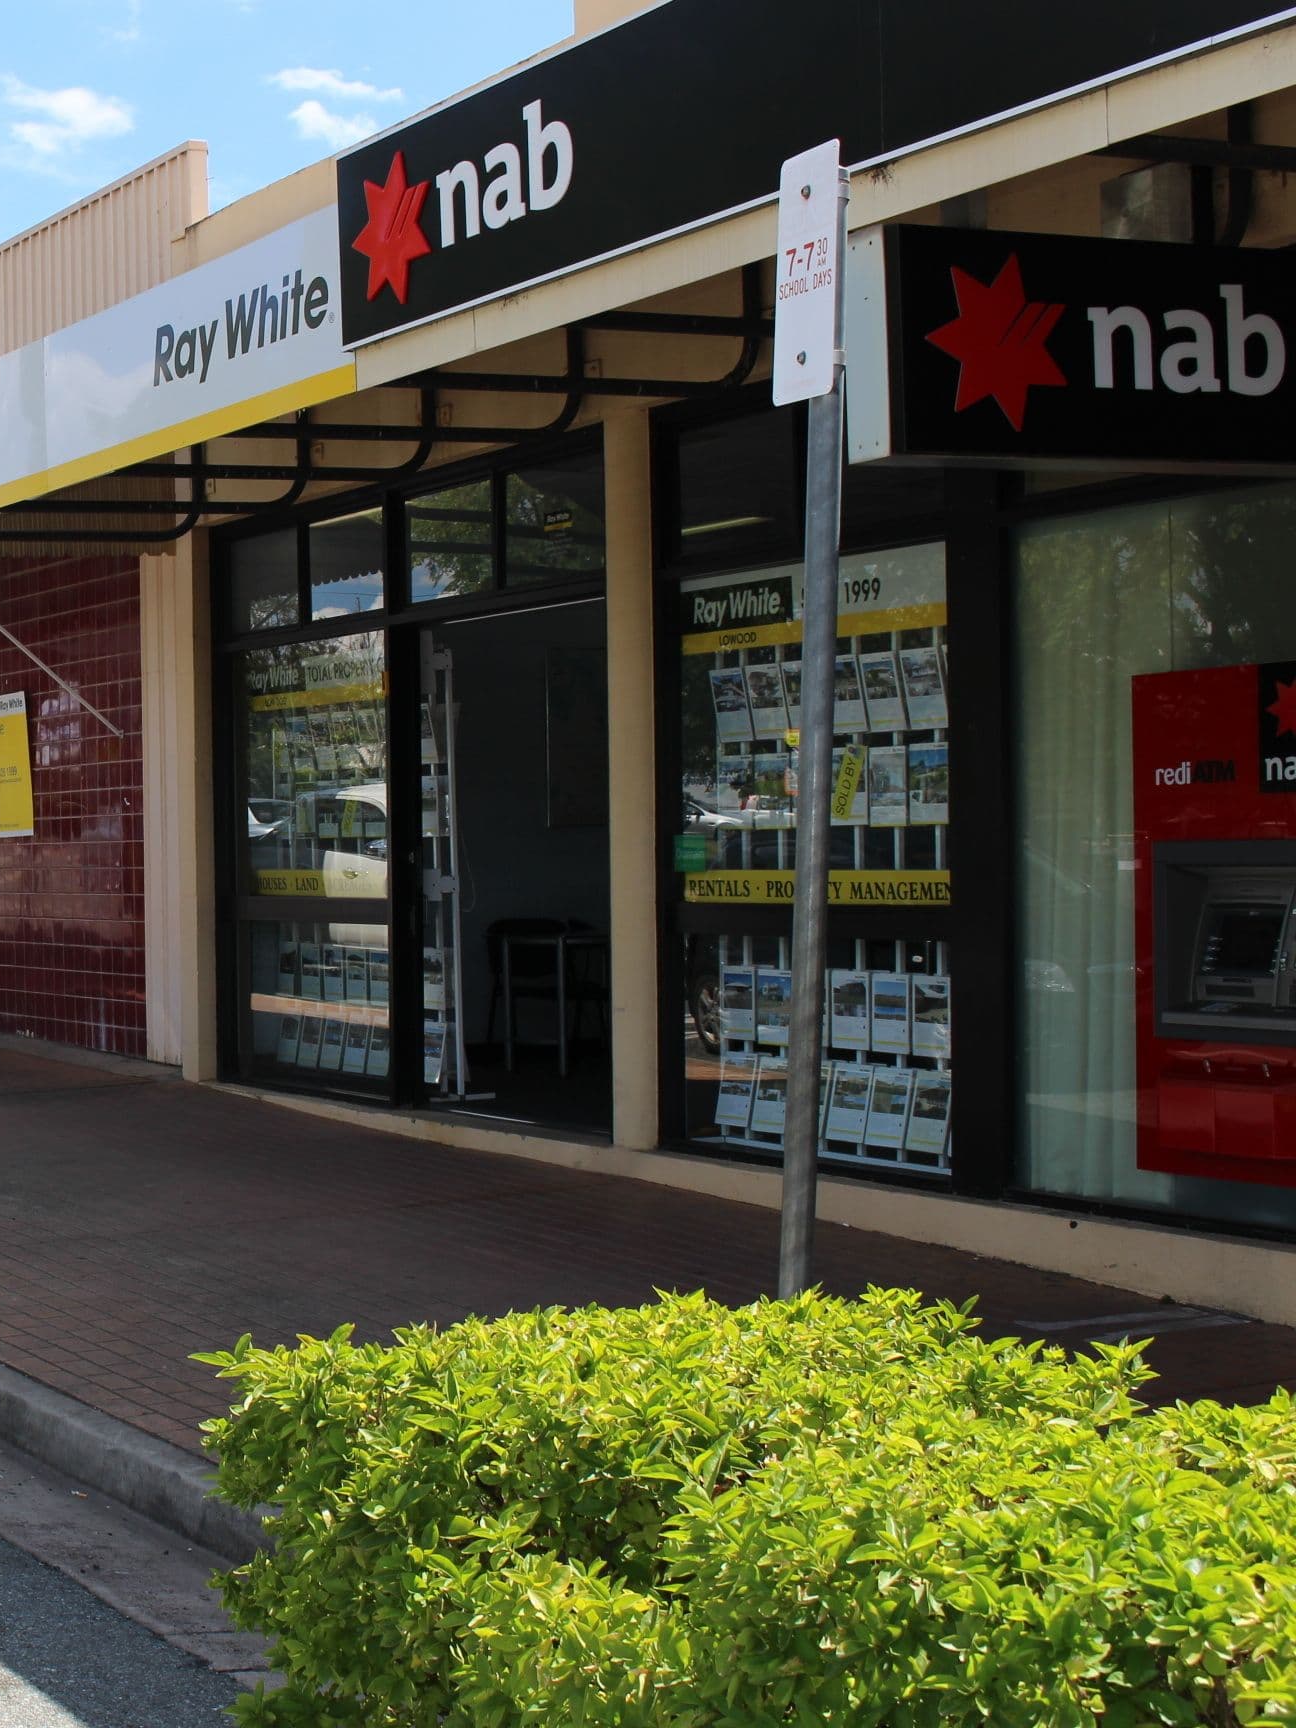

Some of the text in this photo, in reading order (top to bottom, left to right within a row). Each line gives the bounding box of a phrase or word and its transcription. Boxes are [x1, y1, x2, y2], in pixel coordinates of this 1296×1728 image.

[435, 99, 574, 248] nab
[817, 258, 827, 268] AM
[779, 269, 832, 301] SCHOOL DAYS
[153, 269, 329, 386] Ray White
[1087, 284, 1286, 396] nab
[844, 577, 881, 604] 1999
[694, 597, 727, 627] Ray
[729, 588, 781, 619] White
[719, 631, 757, 647] LOWOOD
[1265, 756, 1296, 781] na
[836, 758, 856, 816] SOLD BY
[296, 876, 319, 891] LAND
[689, 879, 750, 897] RENTALS
[850, 881, 951, 900] MANAGEMEN
